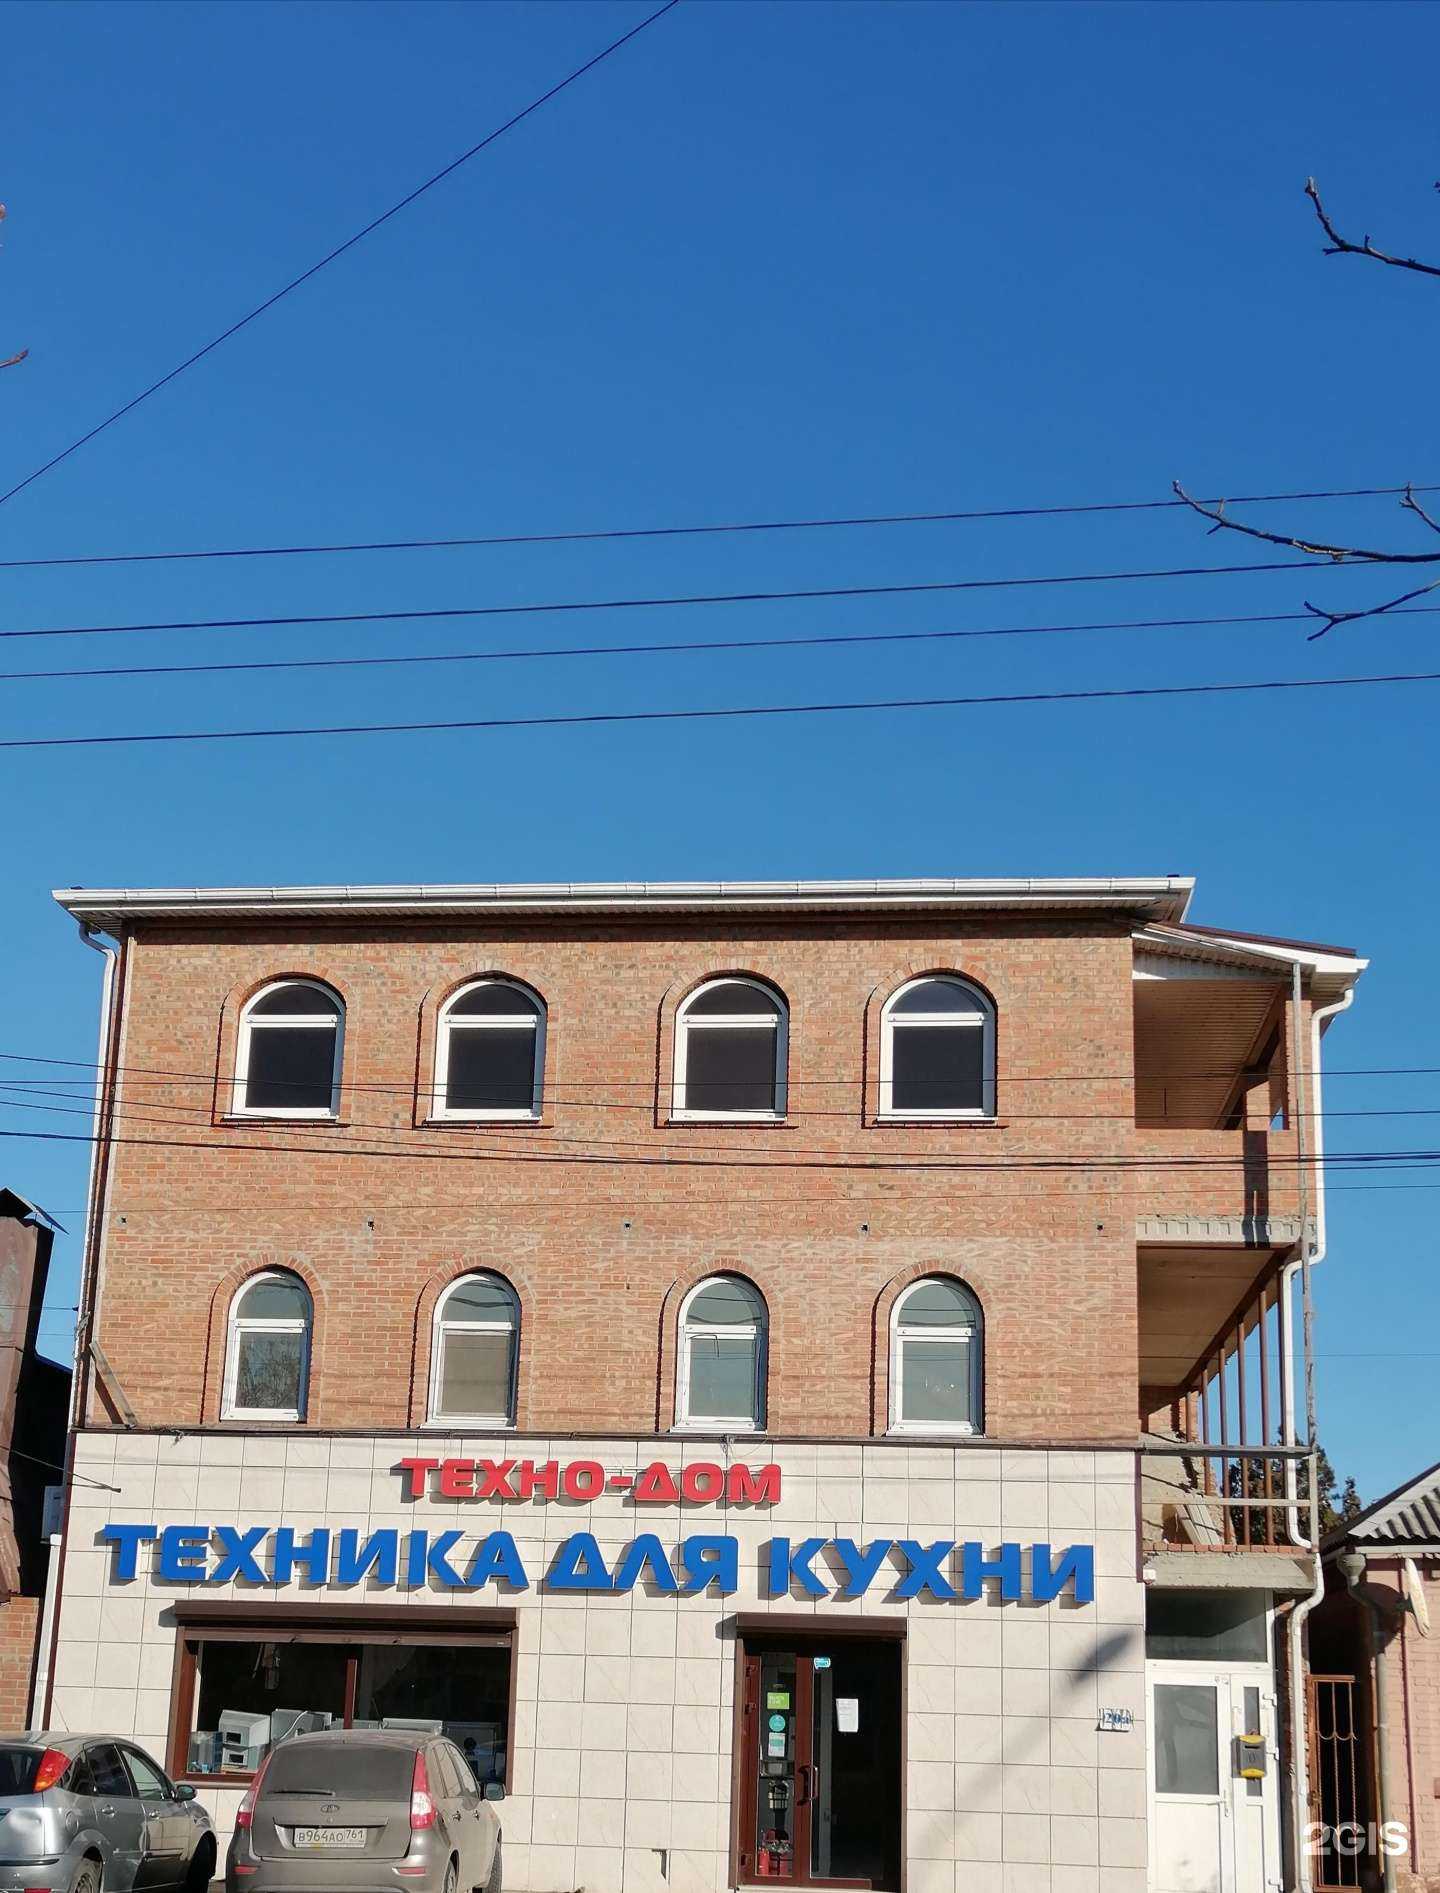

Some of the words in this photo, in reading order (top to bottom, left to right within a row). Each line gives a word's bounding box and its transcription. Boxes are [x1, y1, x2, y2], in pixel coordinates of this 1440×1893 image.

[402, 1458, 781, 1504] ТЕХНО-ДОМ
[105, 1524, 529, 1589] ТЕХНИКА
[547, 1532, 739, 1592] ДЛЯ
[771, 1536, 1094, 1602] КУХНИ
